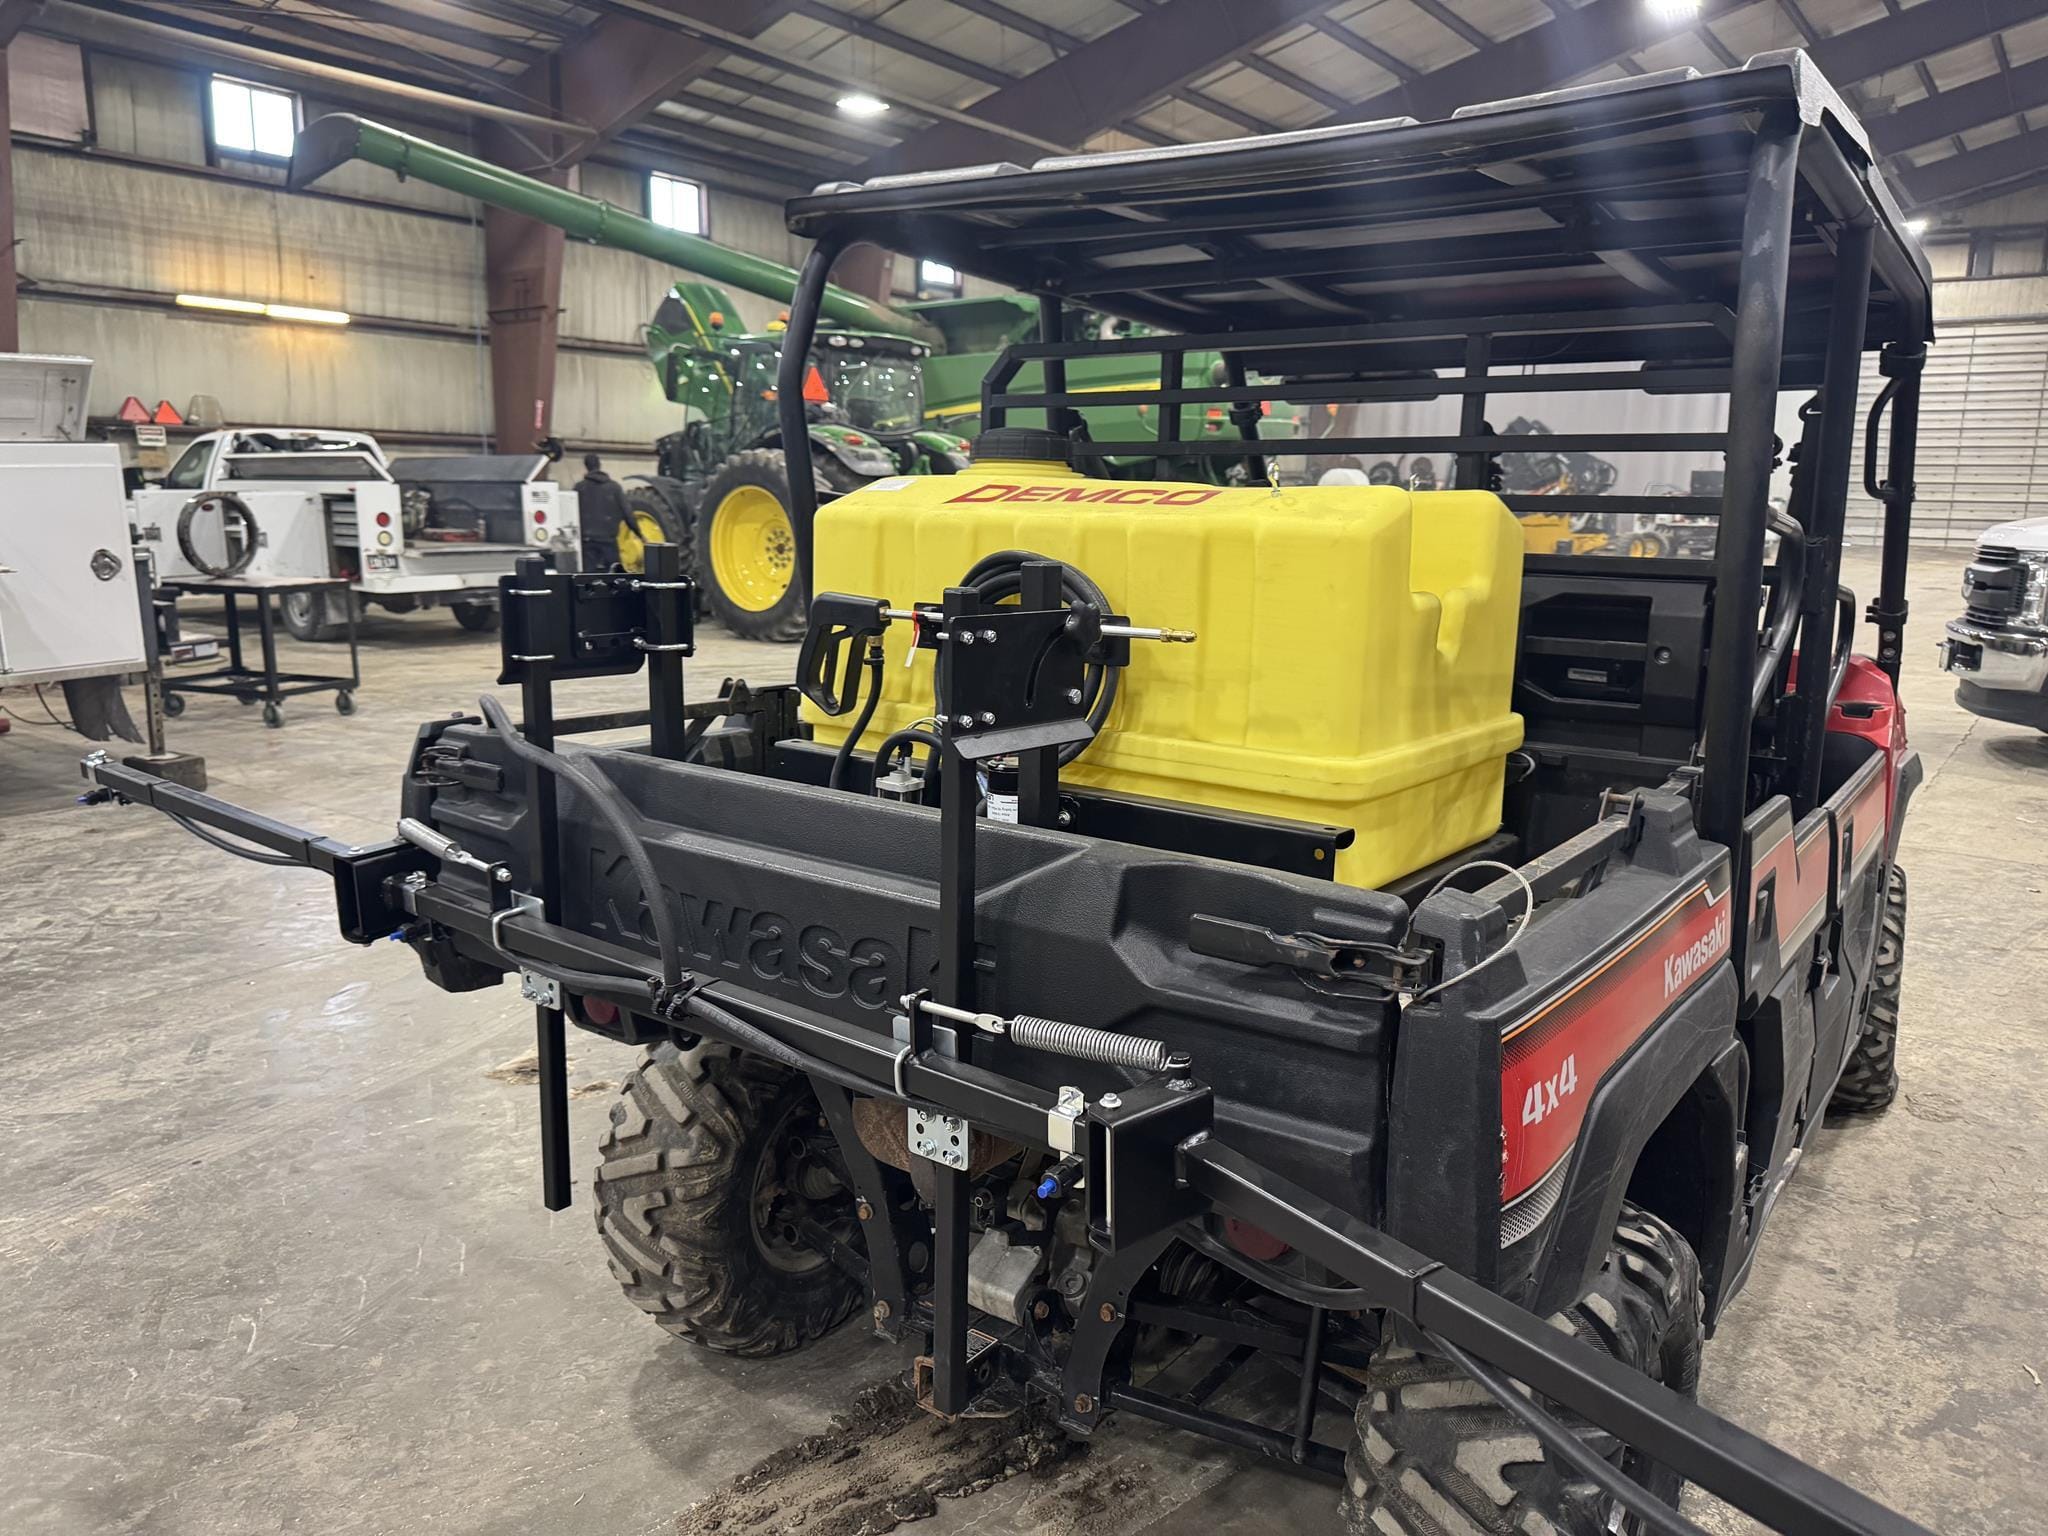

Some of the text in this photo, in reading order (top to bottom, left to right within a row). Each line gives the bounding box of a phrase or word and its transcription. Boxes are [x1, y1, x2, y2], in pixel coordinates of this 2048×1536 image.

[942, 484, 1223, 506] DEMCO
[1663, 909, 1727, 1000] Kawasaki
[1521, 1052, 1579, 1127] 4x4
